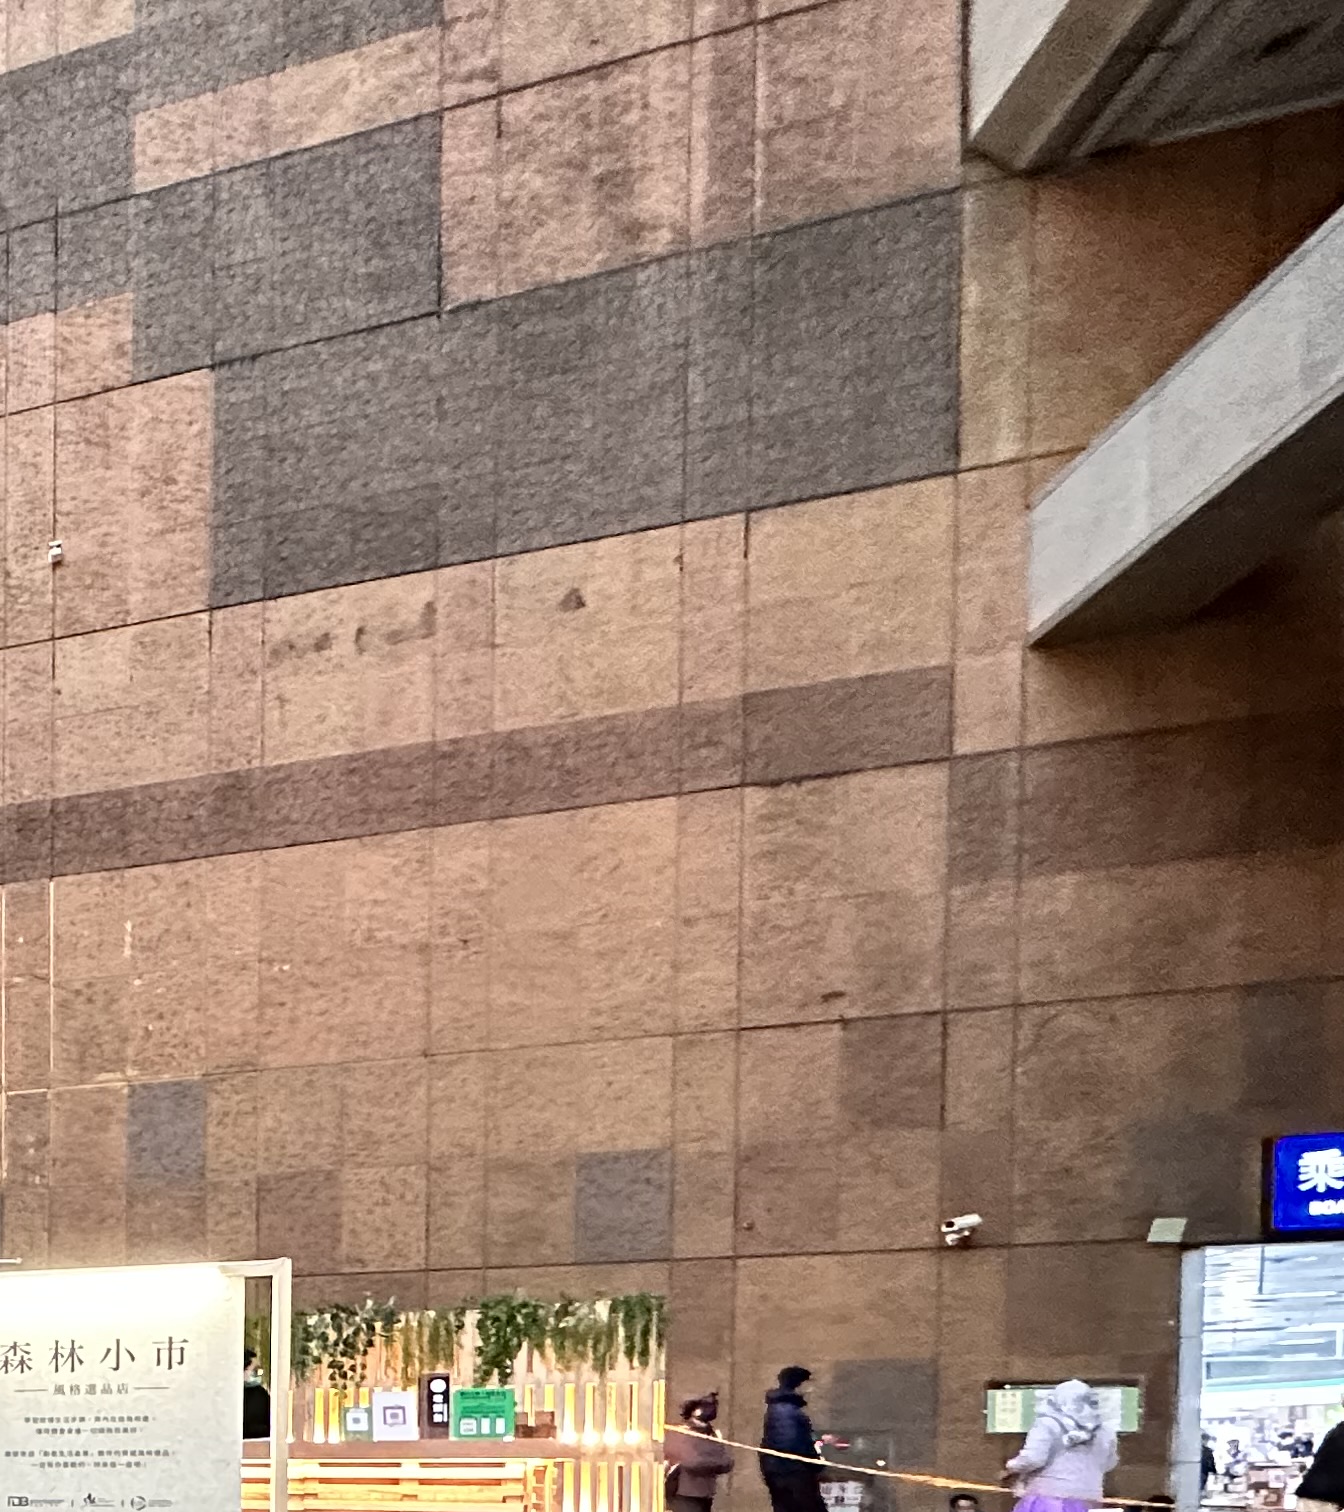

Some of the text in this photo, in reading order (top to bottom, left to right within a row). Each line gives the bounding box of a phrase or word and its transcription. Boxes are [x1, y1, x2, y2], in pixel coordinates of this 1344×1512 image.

[53, 1383, 129, 1395] 風格選品店
